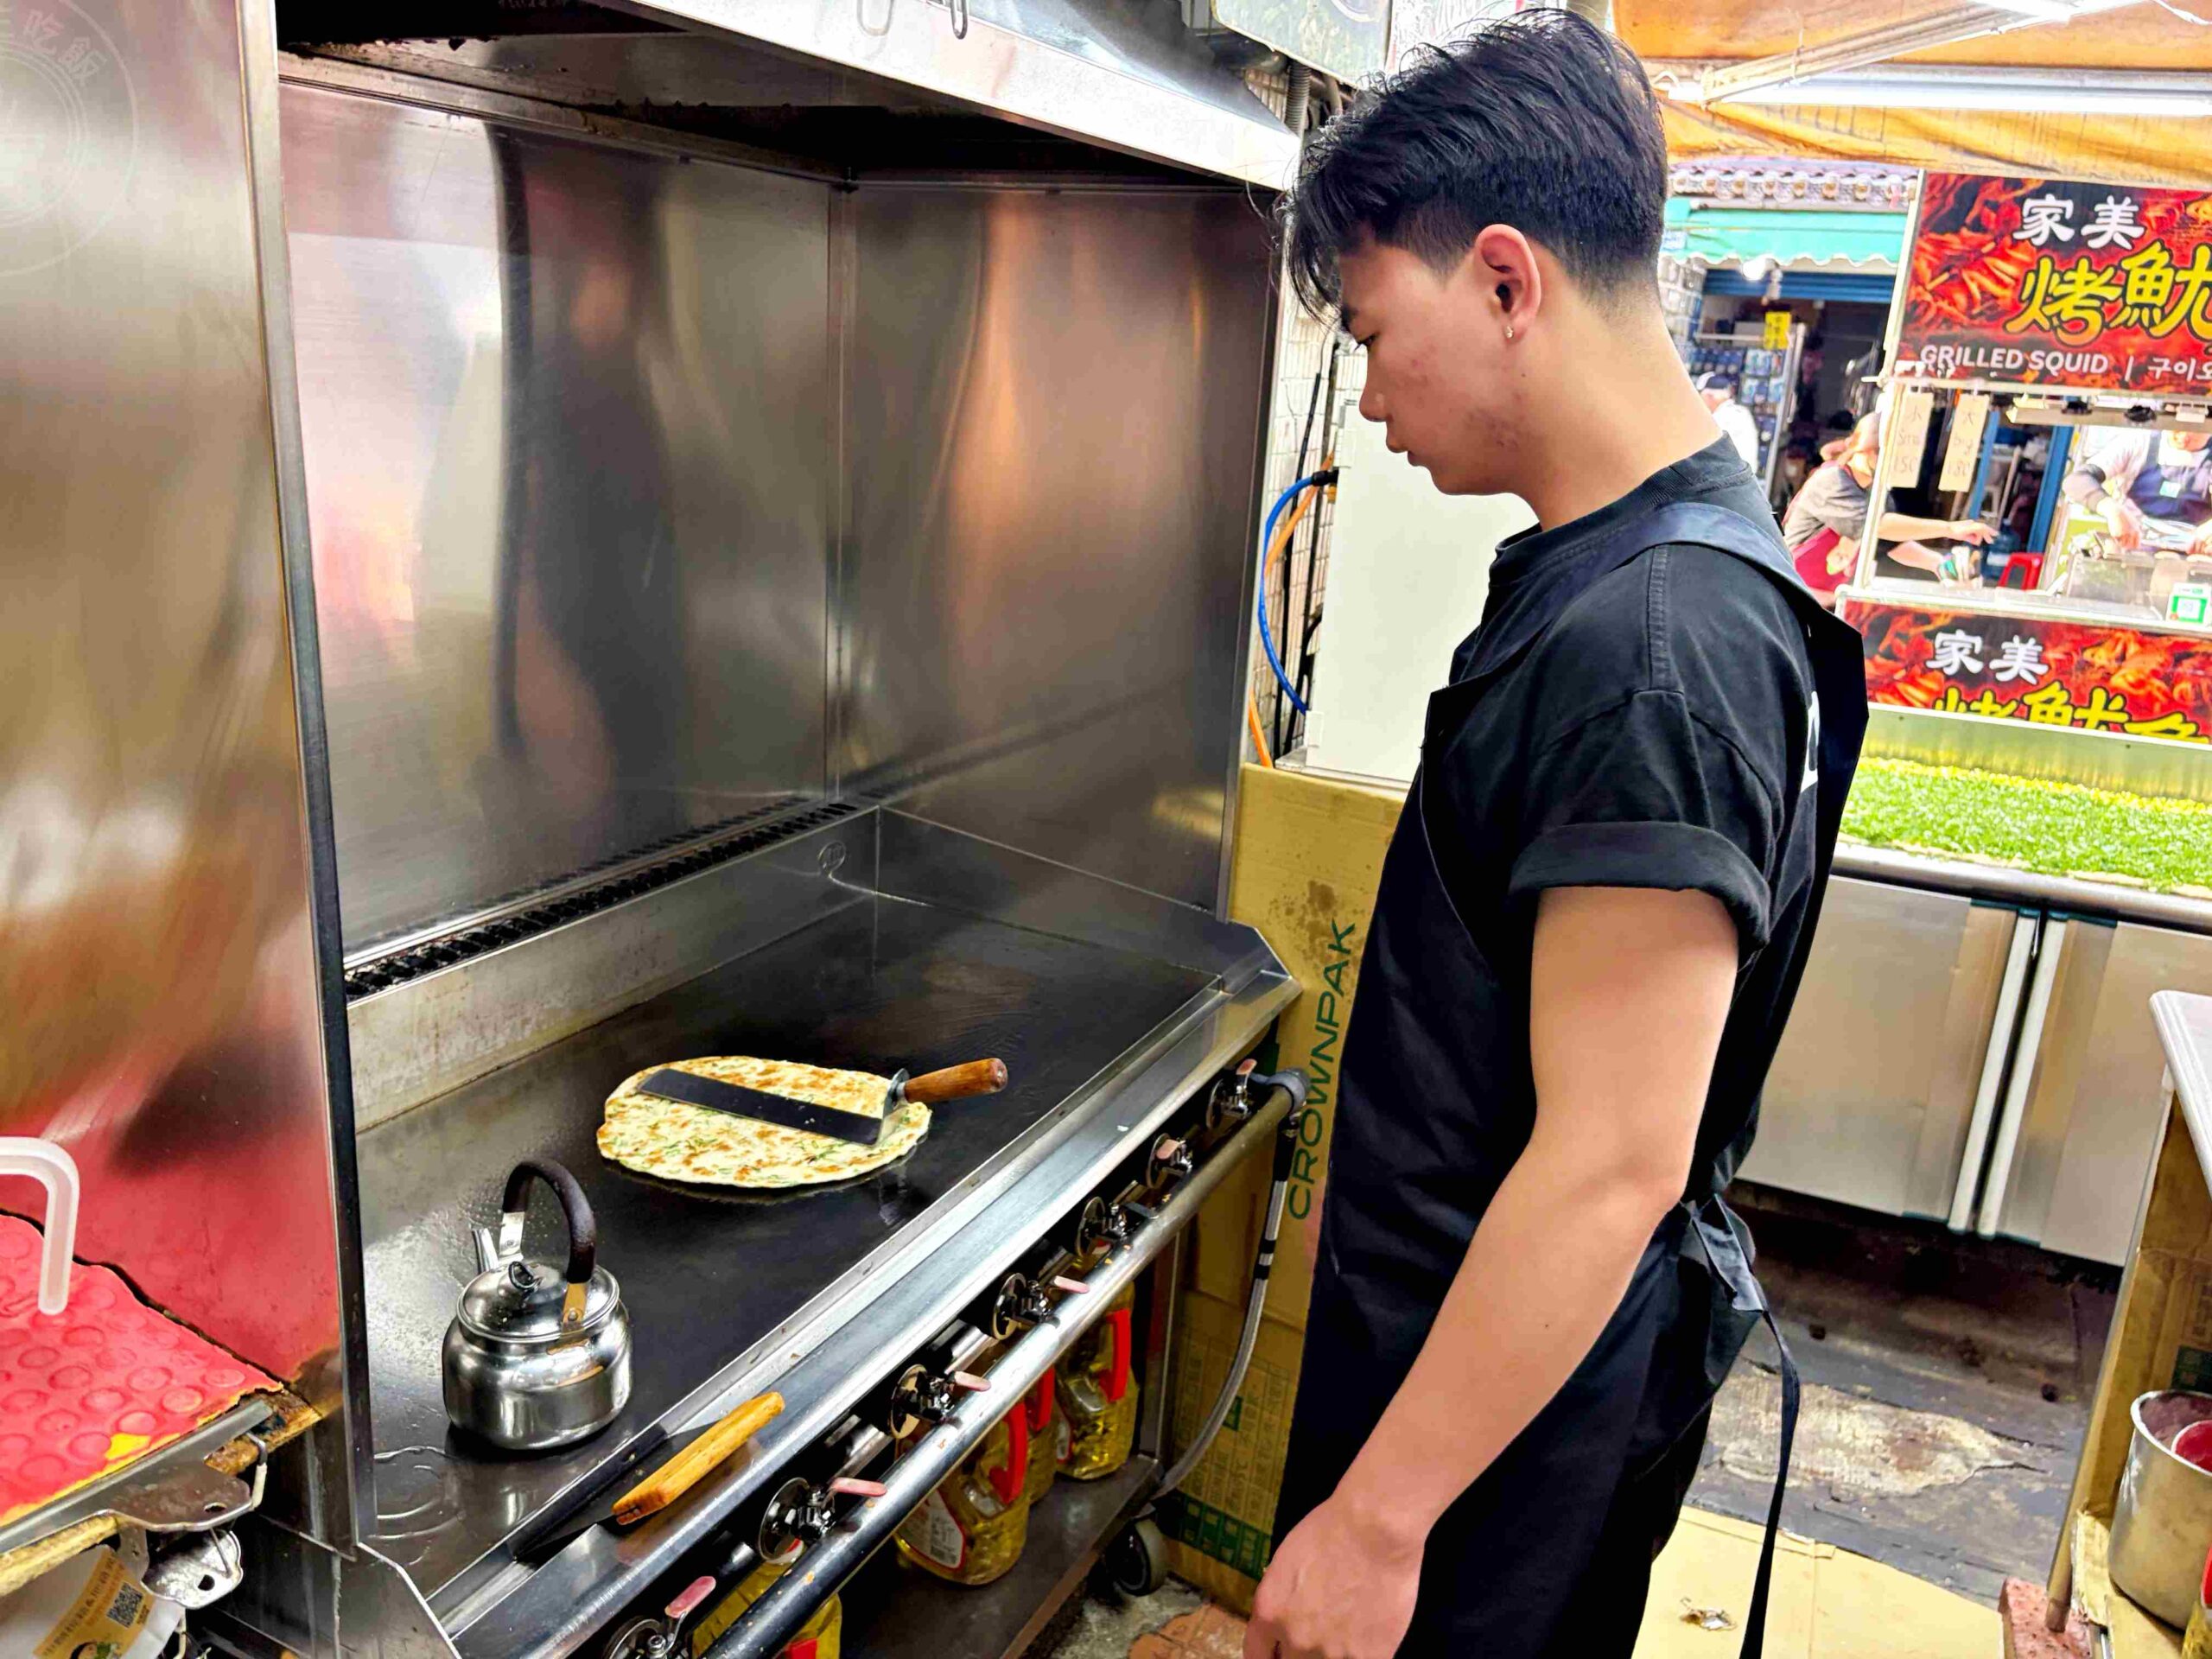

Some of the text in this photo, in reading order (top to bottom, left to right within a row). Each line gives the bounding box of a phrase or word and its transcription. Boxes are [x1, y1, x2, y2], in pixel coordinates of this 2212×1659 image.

[2012, 194, 2145, 250] 家美
[1920, 344, 2109, 374] GRILLED SQUID
[1926, 629, 2050, 684] 家美
[1287, 919, 1357, 1221] CROWNPAK
